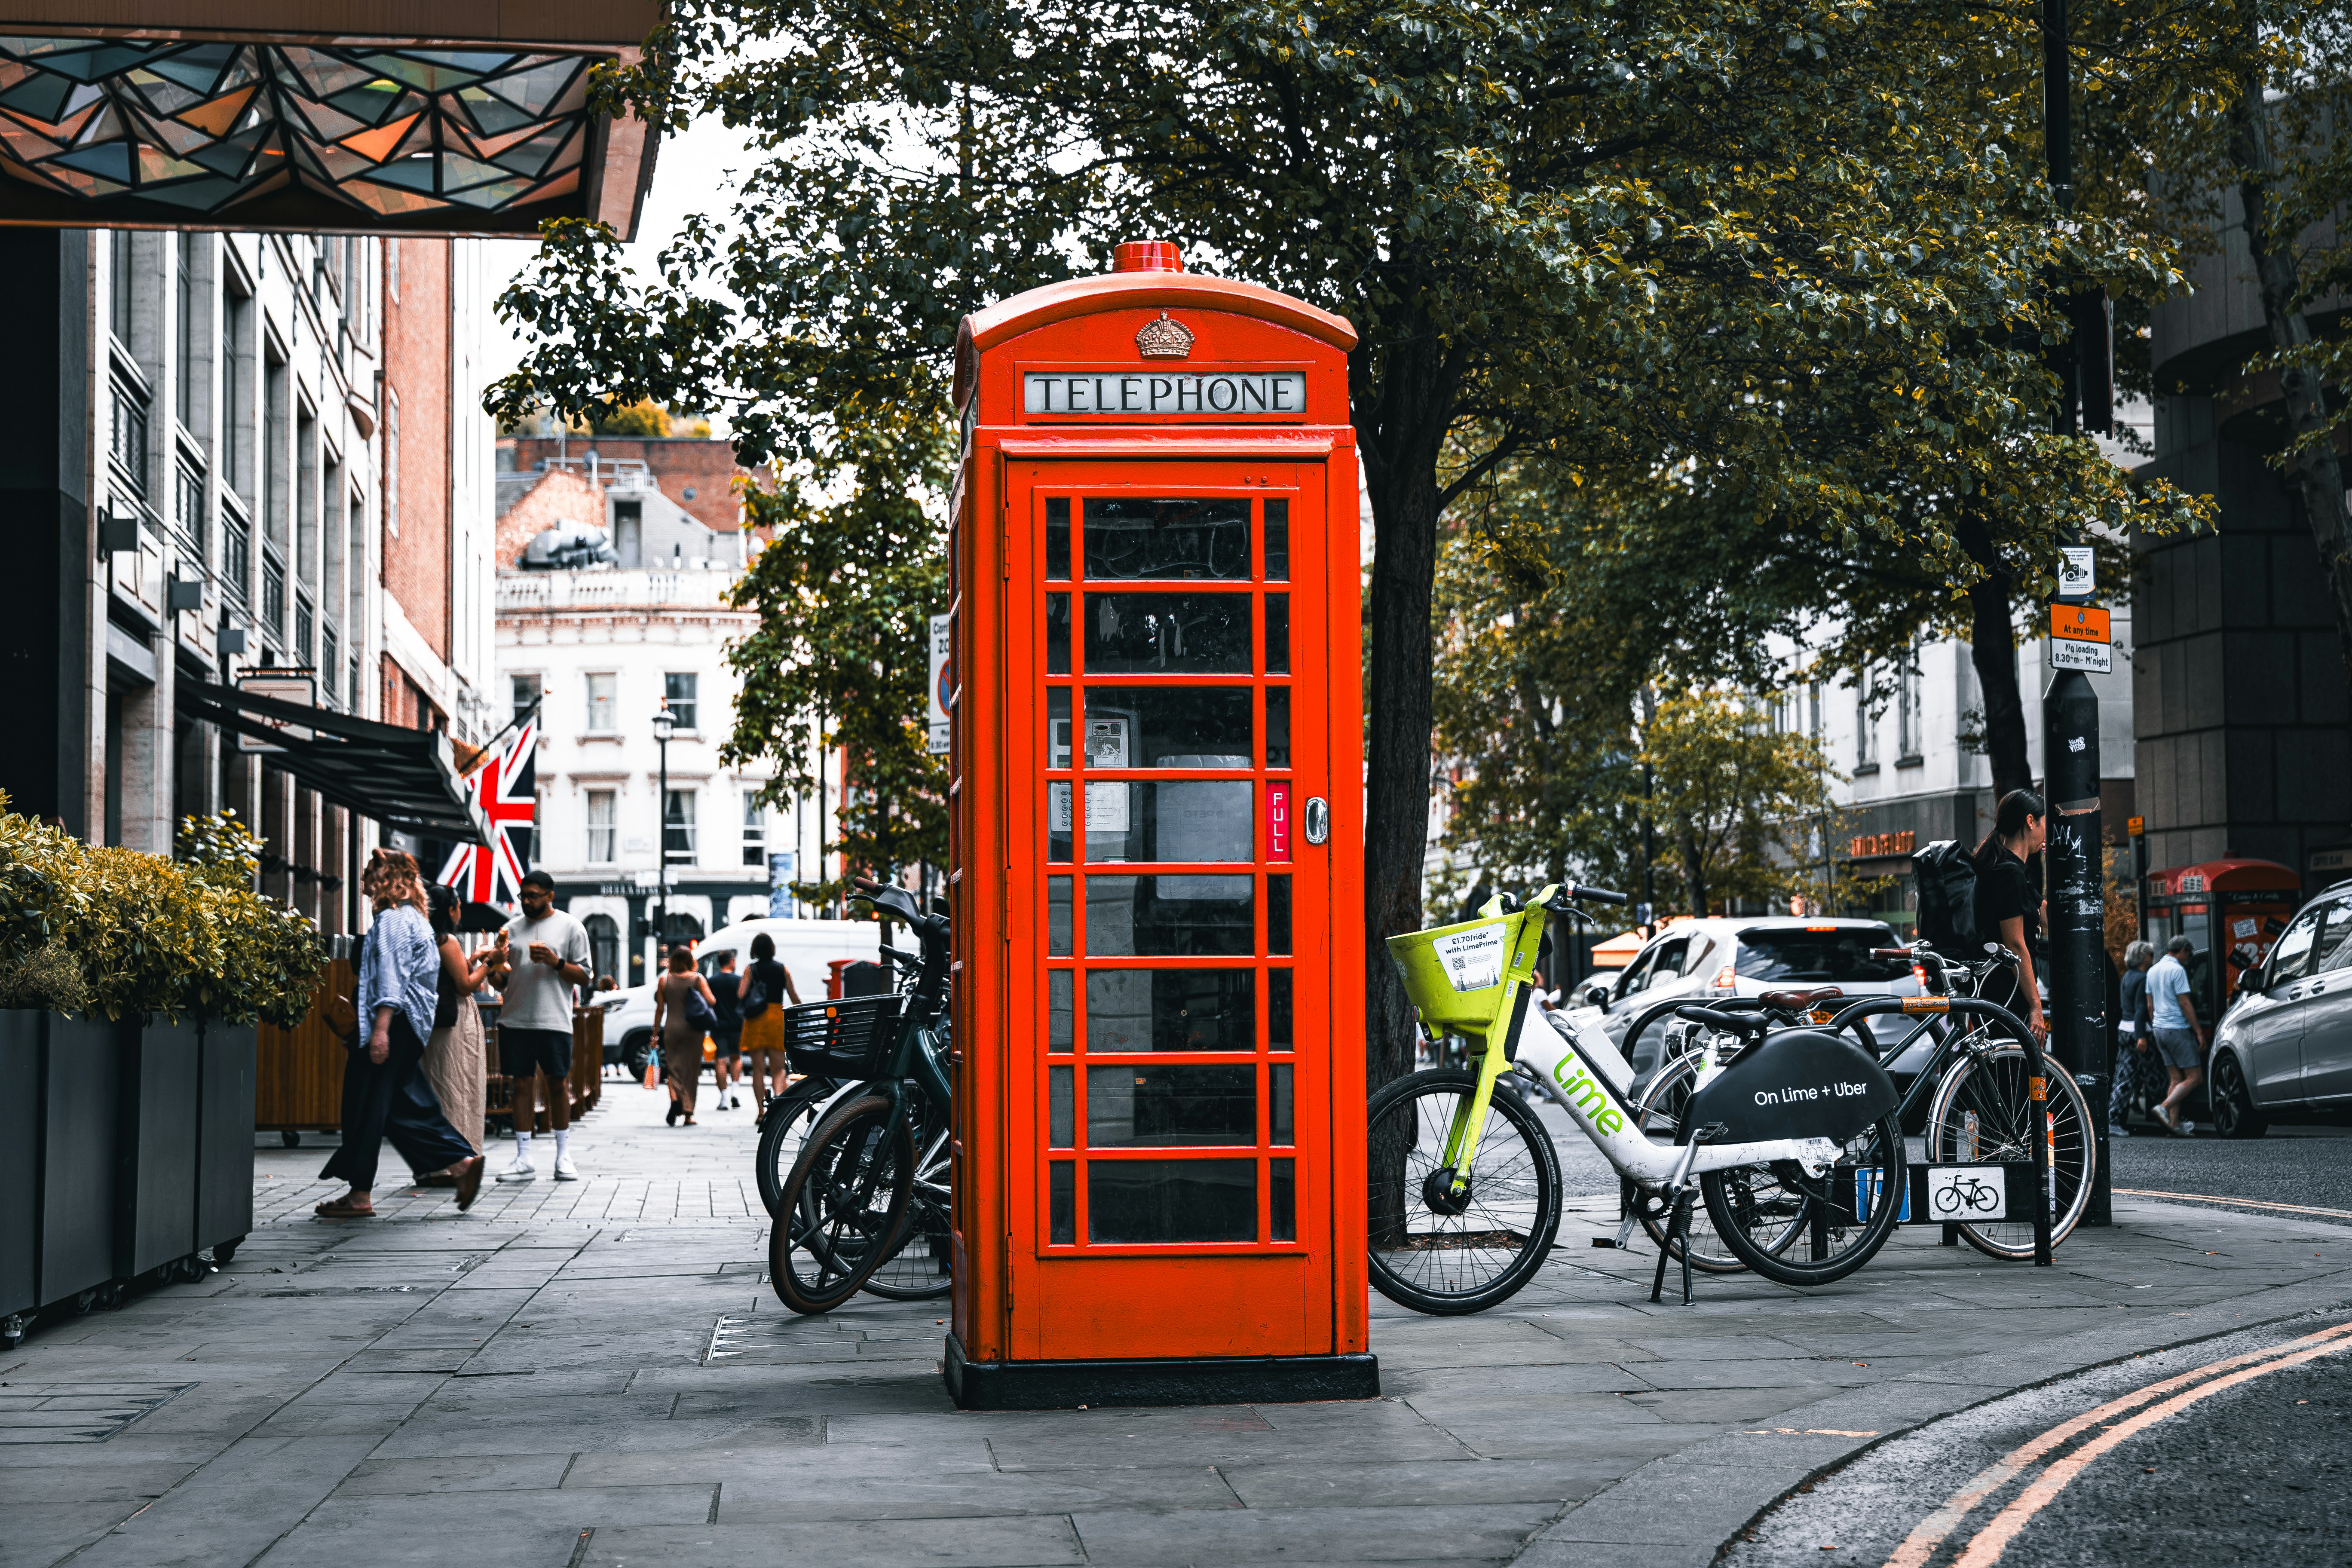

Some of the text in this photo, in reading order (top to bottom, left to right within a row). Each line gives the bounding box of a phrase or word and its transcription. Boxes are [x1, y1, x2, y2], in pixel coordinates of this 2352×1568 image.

[1032, 378, 1293, 411] TELEPHONE
[2064, 624, 2099, 637] At any time
[2065, 643, 2098, 656] No loading
[2086, 655, 2108, 668] M'night
[1273, 792, 1284, 852] PULL
[1446, 940, 1498, 954] with LimePrime
[1755, 1090, 1779, 1106] On
[1781, 1087, 1818, 1102] Lime
[1834, 1081, 1867, 1097] Uber
